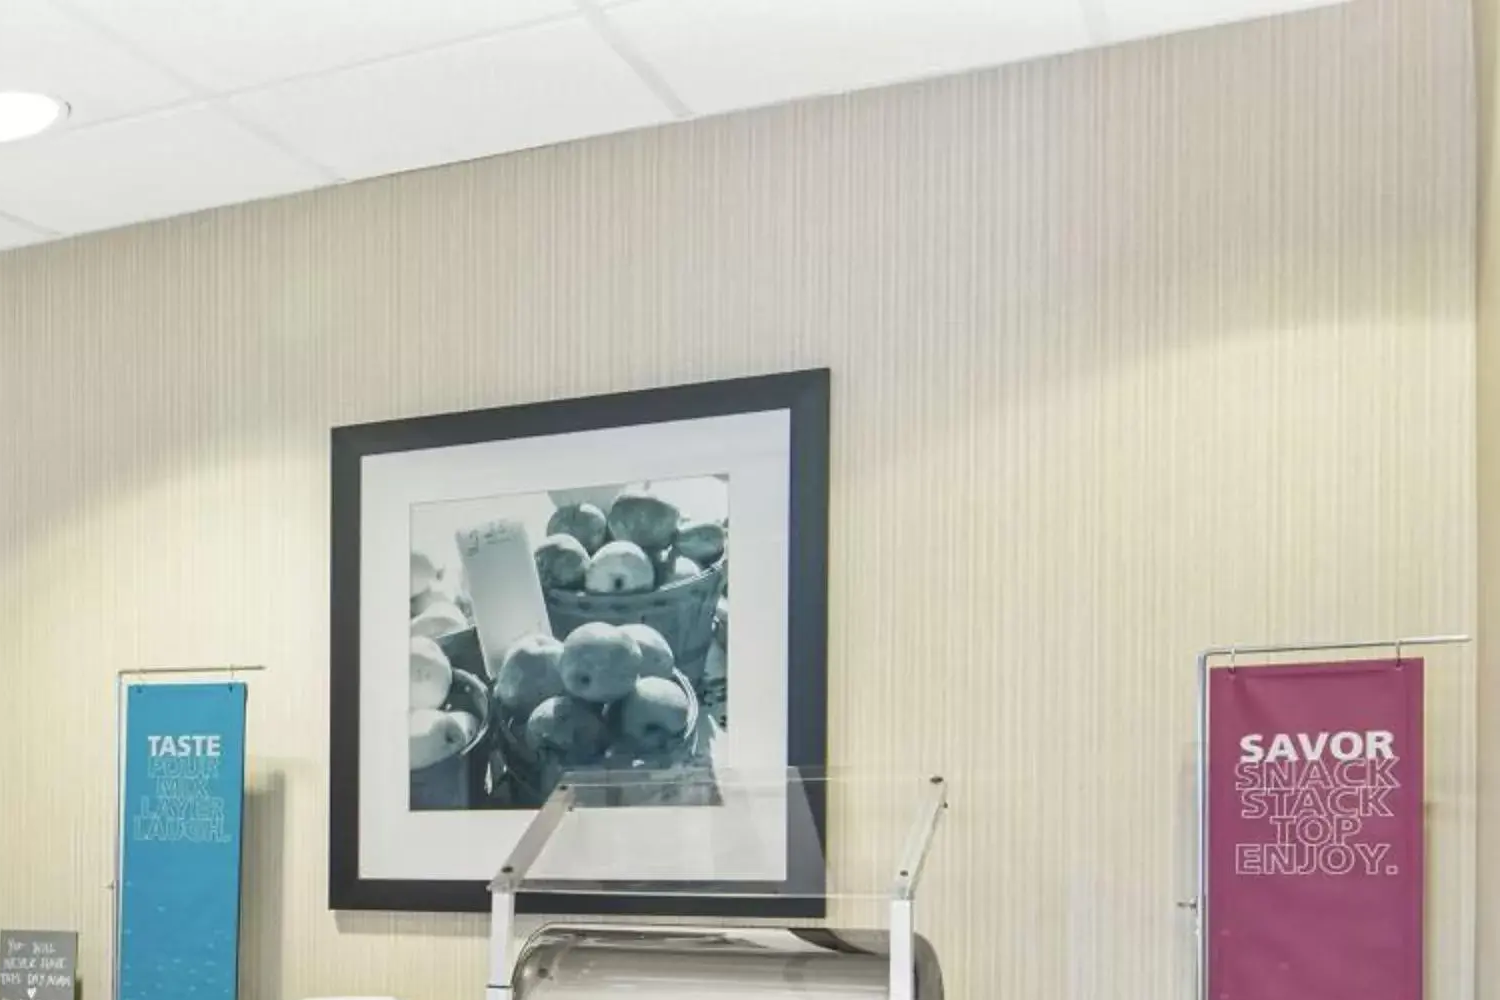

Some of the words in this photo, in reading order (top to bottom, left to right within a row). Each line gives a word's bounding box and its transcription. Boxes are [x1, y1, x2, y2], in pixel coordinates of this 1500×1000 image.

[147, 735, 221, 757] TASTE
[1239, 730, 1395, 763] SAVOR
[147, 756, 221, 779] POUR
[1234, 756, 1401, 790] SNACK
[156, 775, 212, 799] MIX
[1241, 785, 1394, 818] STACK
[141, 796, 225, 819] LAYER
[1269, 814, 1362, 846] TOP
[1235, 843, 1399, 875] ENJOY.
